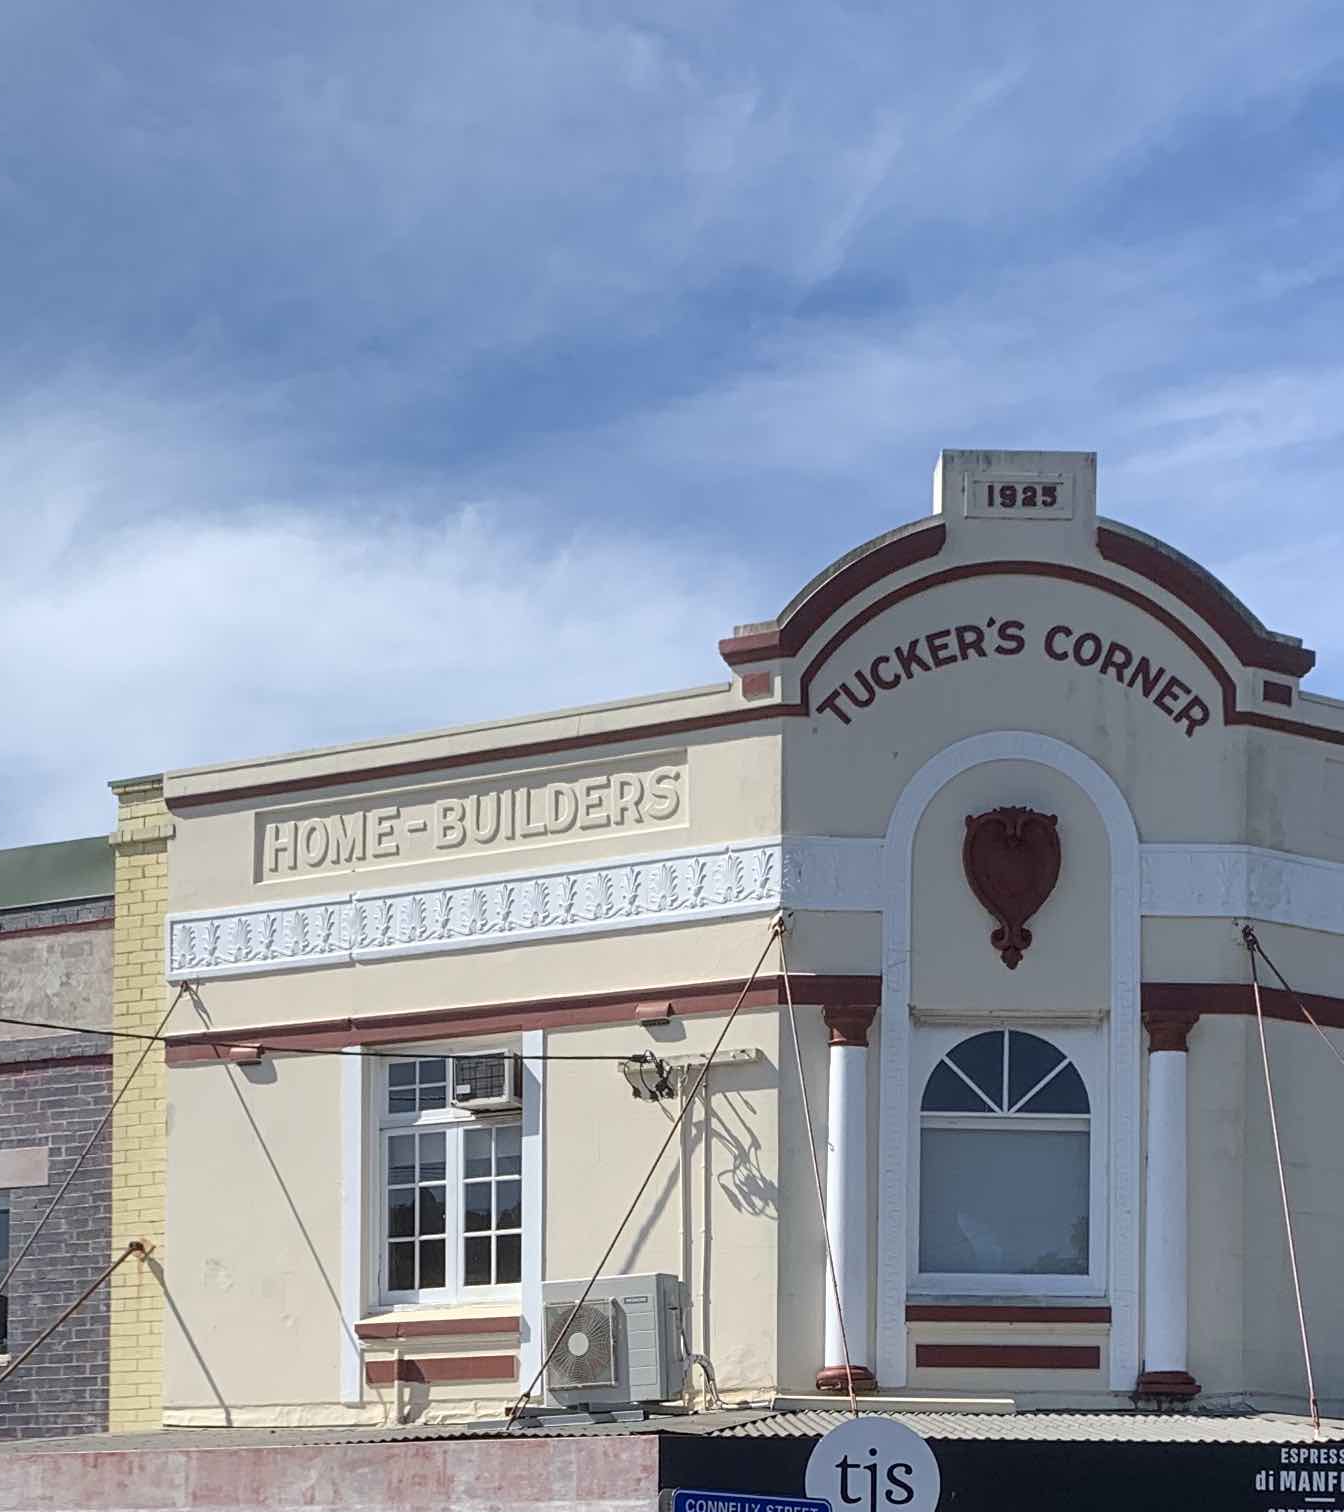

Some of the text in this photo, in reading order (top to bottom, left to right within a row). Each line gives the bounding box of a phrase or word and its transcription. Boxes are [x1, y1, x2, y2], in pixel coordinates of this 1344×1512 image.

[987, 484, 1058, 508] 1925
[816, 616, 1211, 738] TUCKER'S CORNER
[268, 765, 681, 873] HOME-BUILDERS
[1256, 1471, 1274, 1491] di
